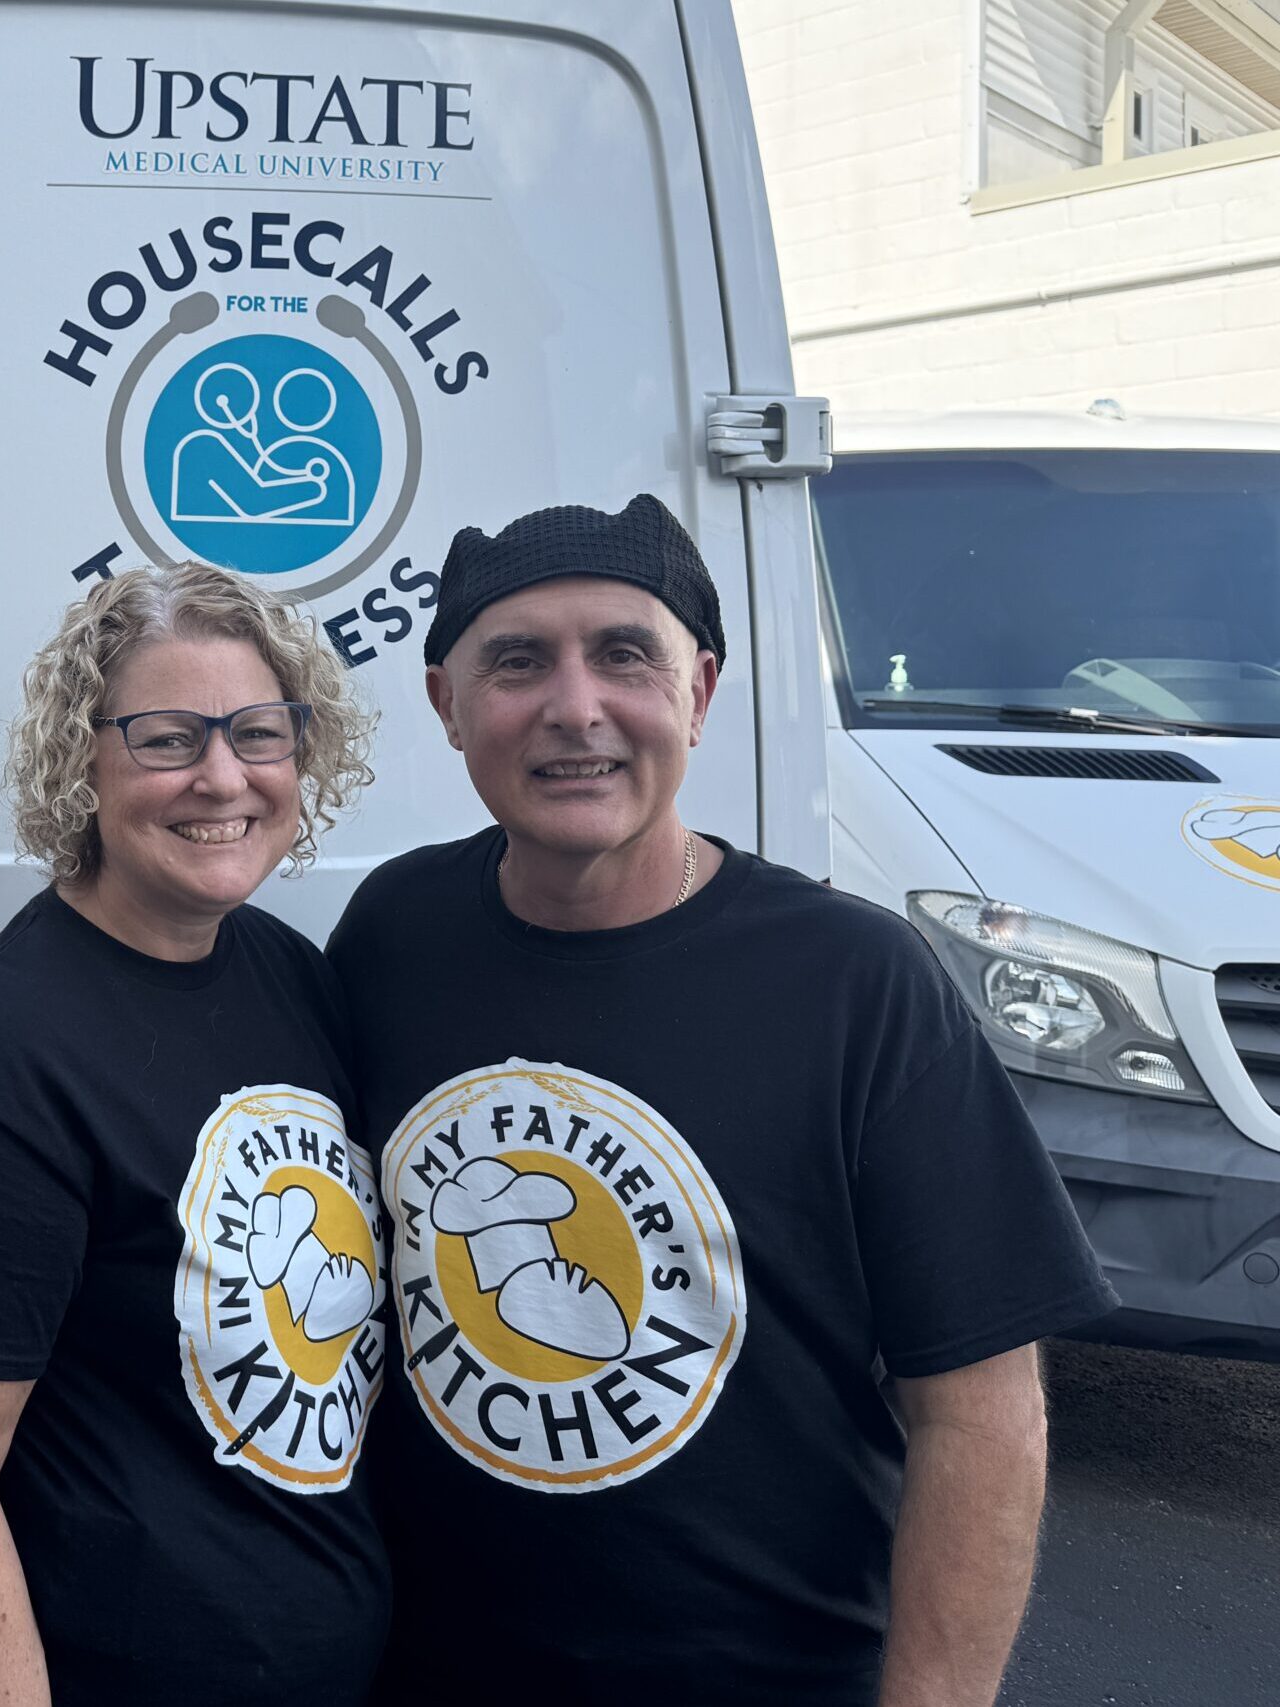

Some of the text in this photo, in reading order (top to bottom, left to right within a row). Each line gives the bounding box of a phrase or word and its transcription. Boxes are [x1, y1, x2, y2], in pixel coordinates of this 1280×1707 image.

[69, 55, 475, 151] UPSTATE
[105, 151, 446, 182] MEDICAL UNIVERSITY
[43, 211, 489, 395] HOUSECALLS
[226, 295, 308, 313] FOR THE
[213, 1174, 250, 1253] MY
[410, 1119, 467, 1190] MY
[490, 1104, 691, 1294] FATHER'S
[217, 1276, 252, 1329] IN
[402, 1275, 715, 1462] KITCHEN
